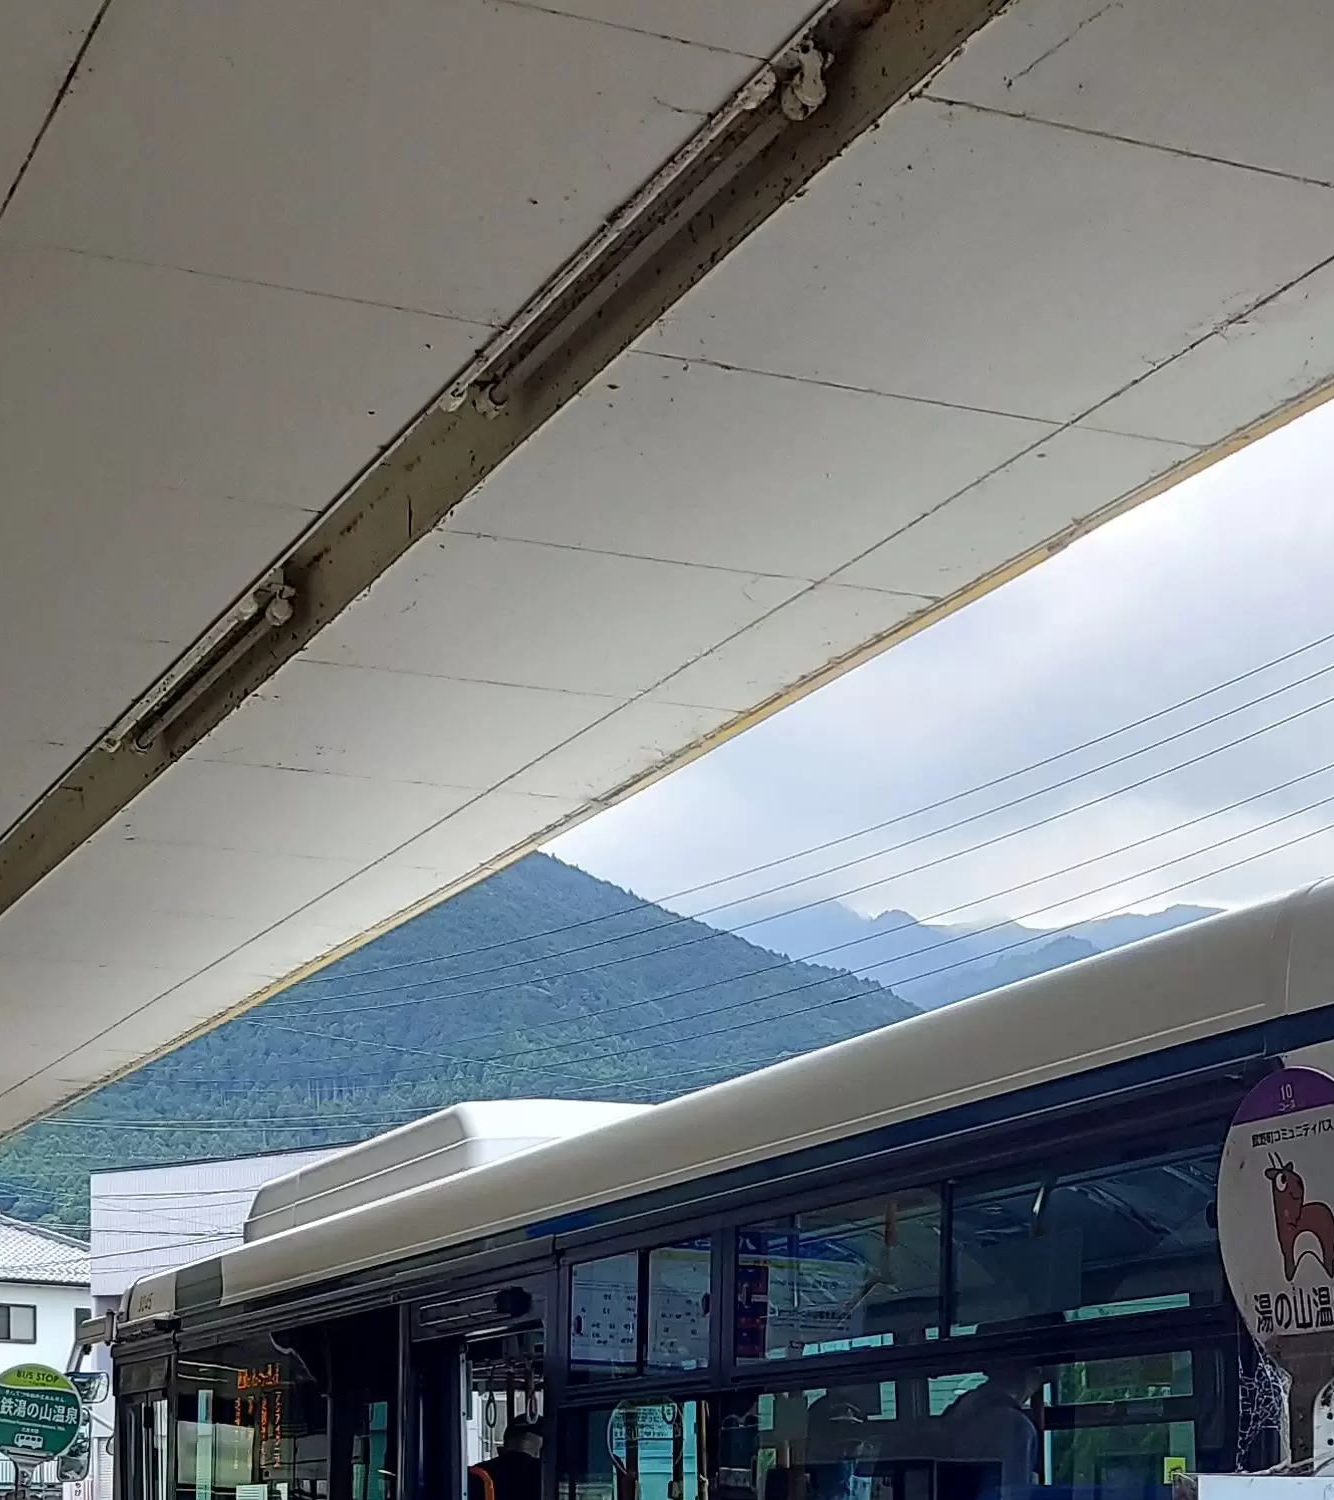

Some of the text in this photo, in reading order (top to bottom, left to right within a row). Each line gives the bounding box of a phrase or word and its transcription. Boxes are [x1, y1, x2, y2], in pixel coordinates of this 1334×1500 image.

[1280, 1083, 1293, 1101] 10
[17, 1370, 33, 1379] BUS
[36, 1371, 59, 1383] STOP
